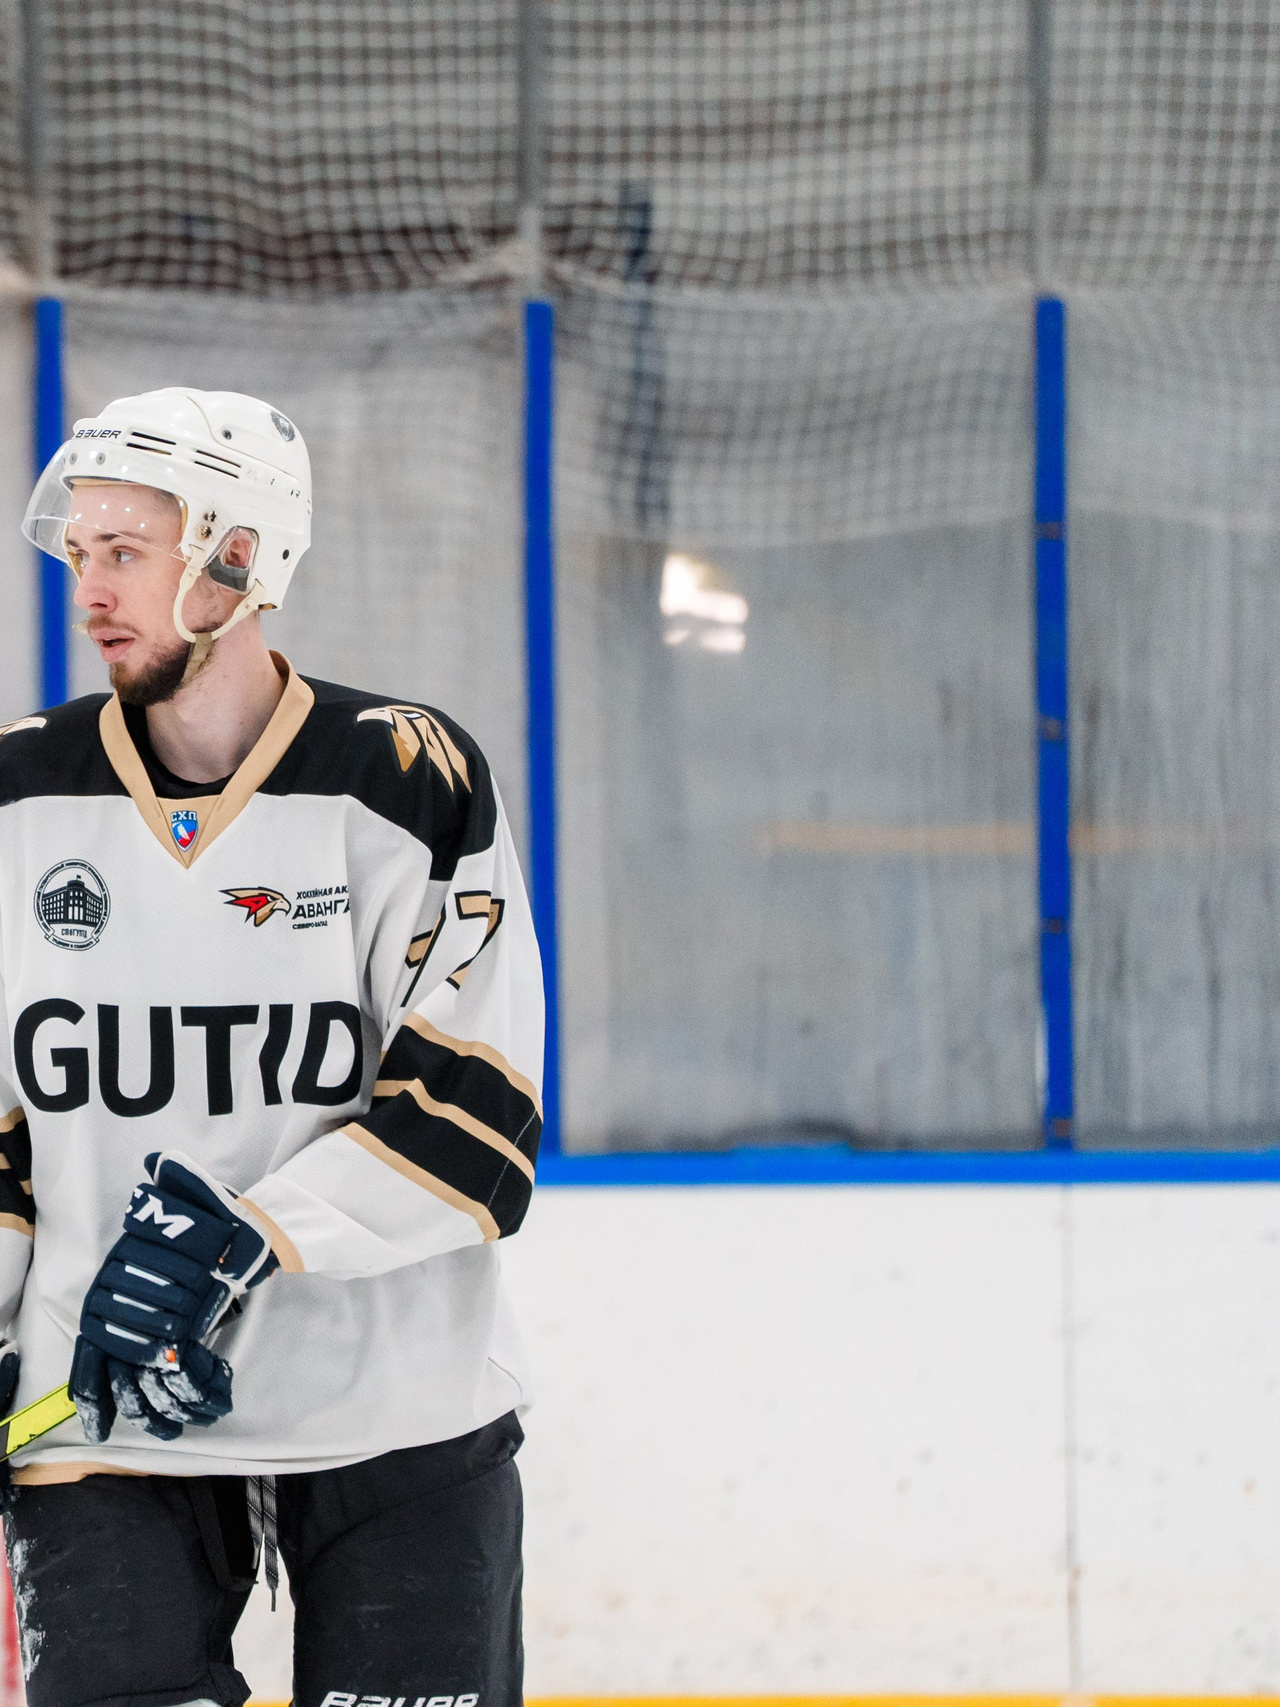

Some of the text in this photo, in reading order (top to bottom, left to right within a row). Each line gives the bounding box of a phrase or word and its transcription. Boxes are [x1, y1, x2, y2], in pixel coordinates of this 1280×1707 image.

[75, 429, 122, 439] BAUER
[171, 811, 197, 821] СХП
[14, 998, 364, 1118] GUTID
